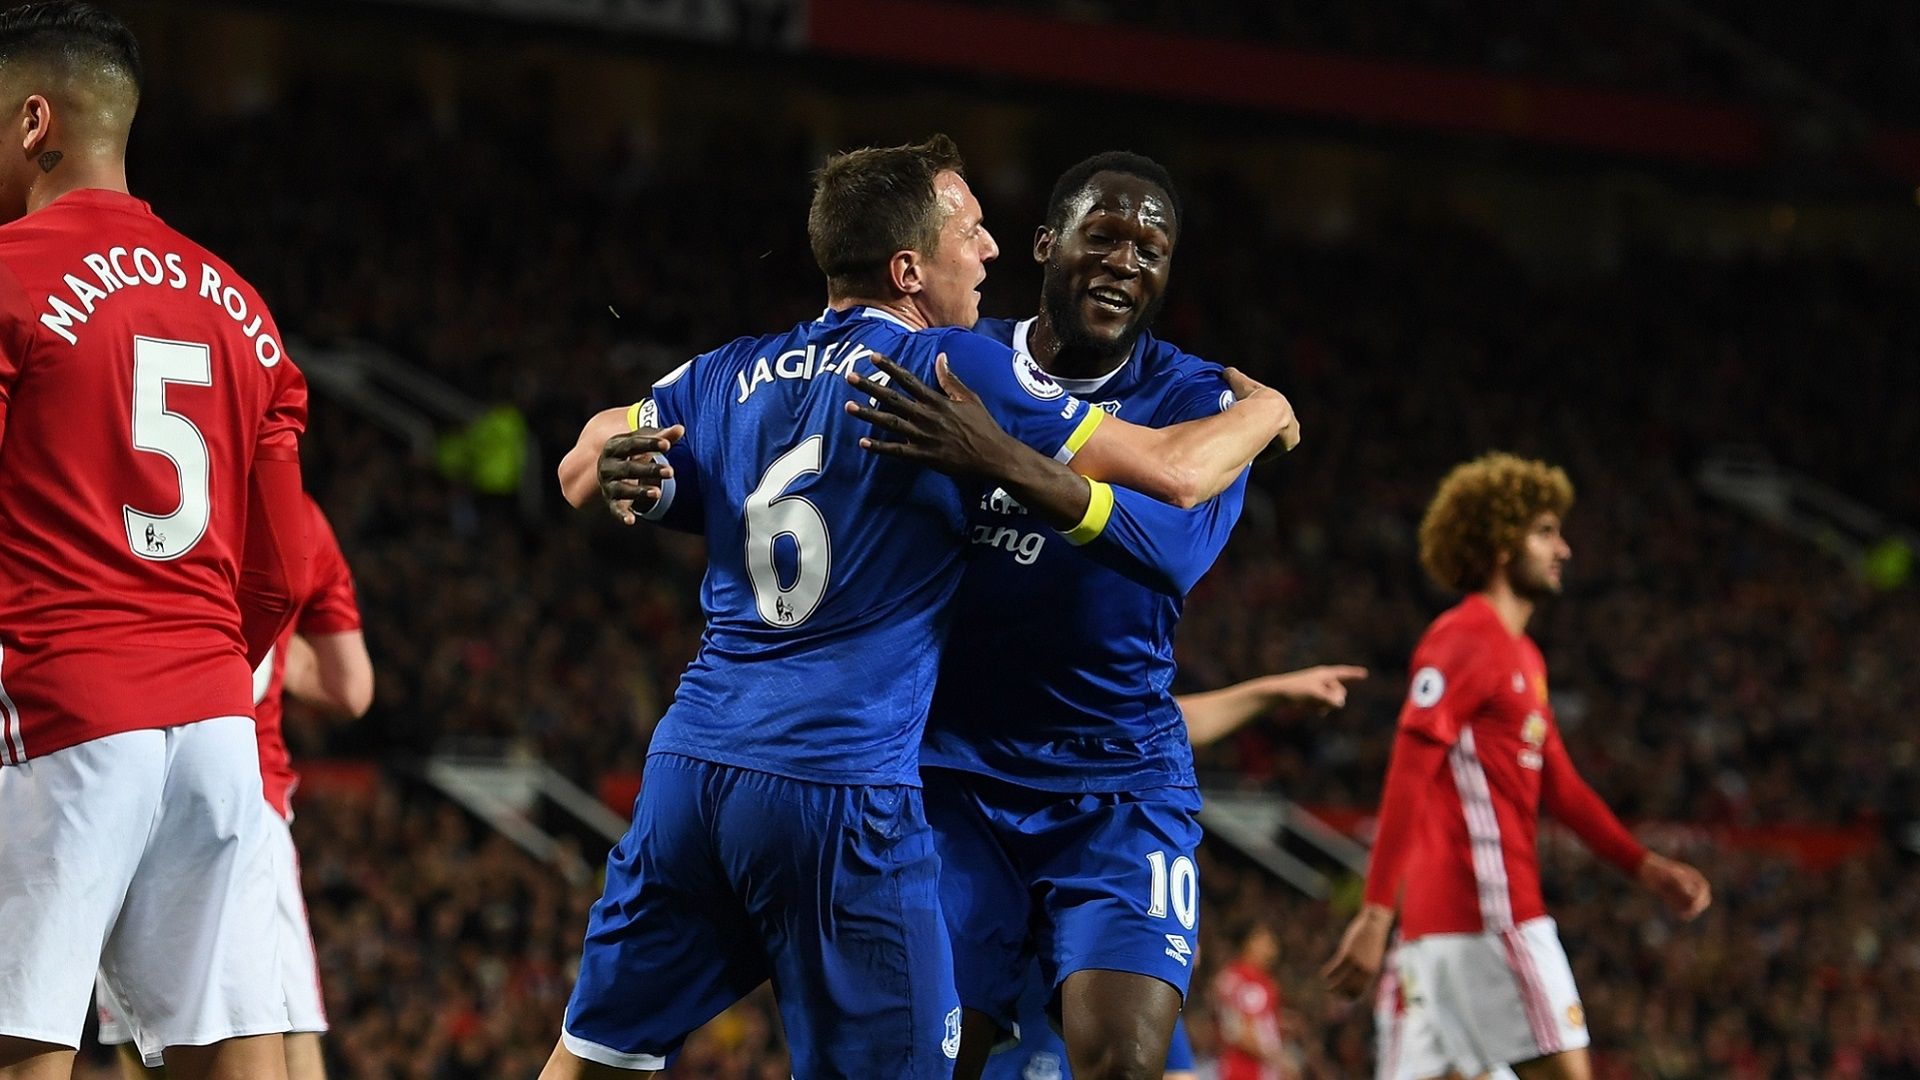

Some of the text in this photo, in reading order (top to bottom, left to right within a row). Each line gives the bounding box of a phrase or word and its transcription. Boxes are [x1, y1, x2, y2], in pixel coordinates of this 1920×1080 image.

[40, 246, 281, 368] MARCOS ROJO
[123, 334, 212, 561] 5
[744, 434, 831, 629] 6
[971, 524, 1046, 565] ang
[1146, 850, 1196, 930] 10
